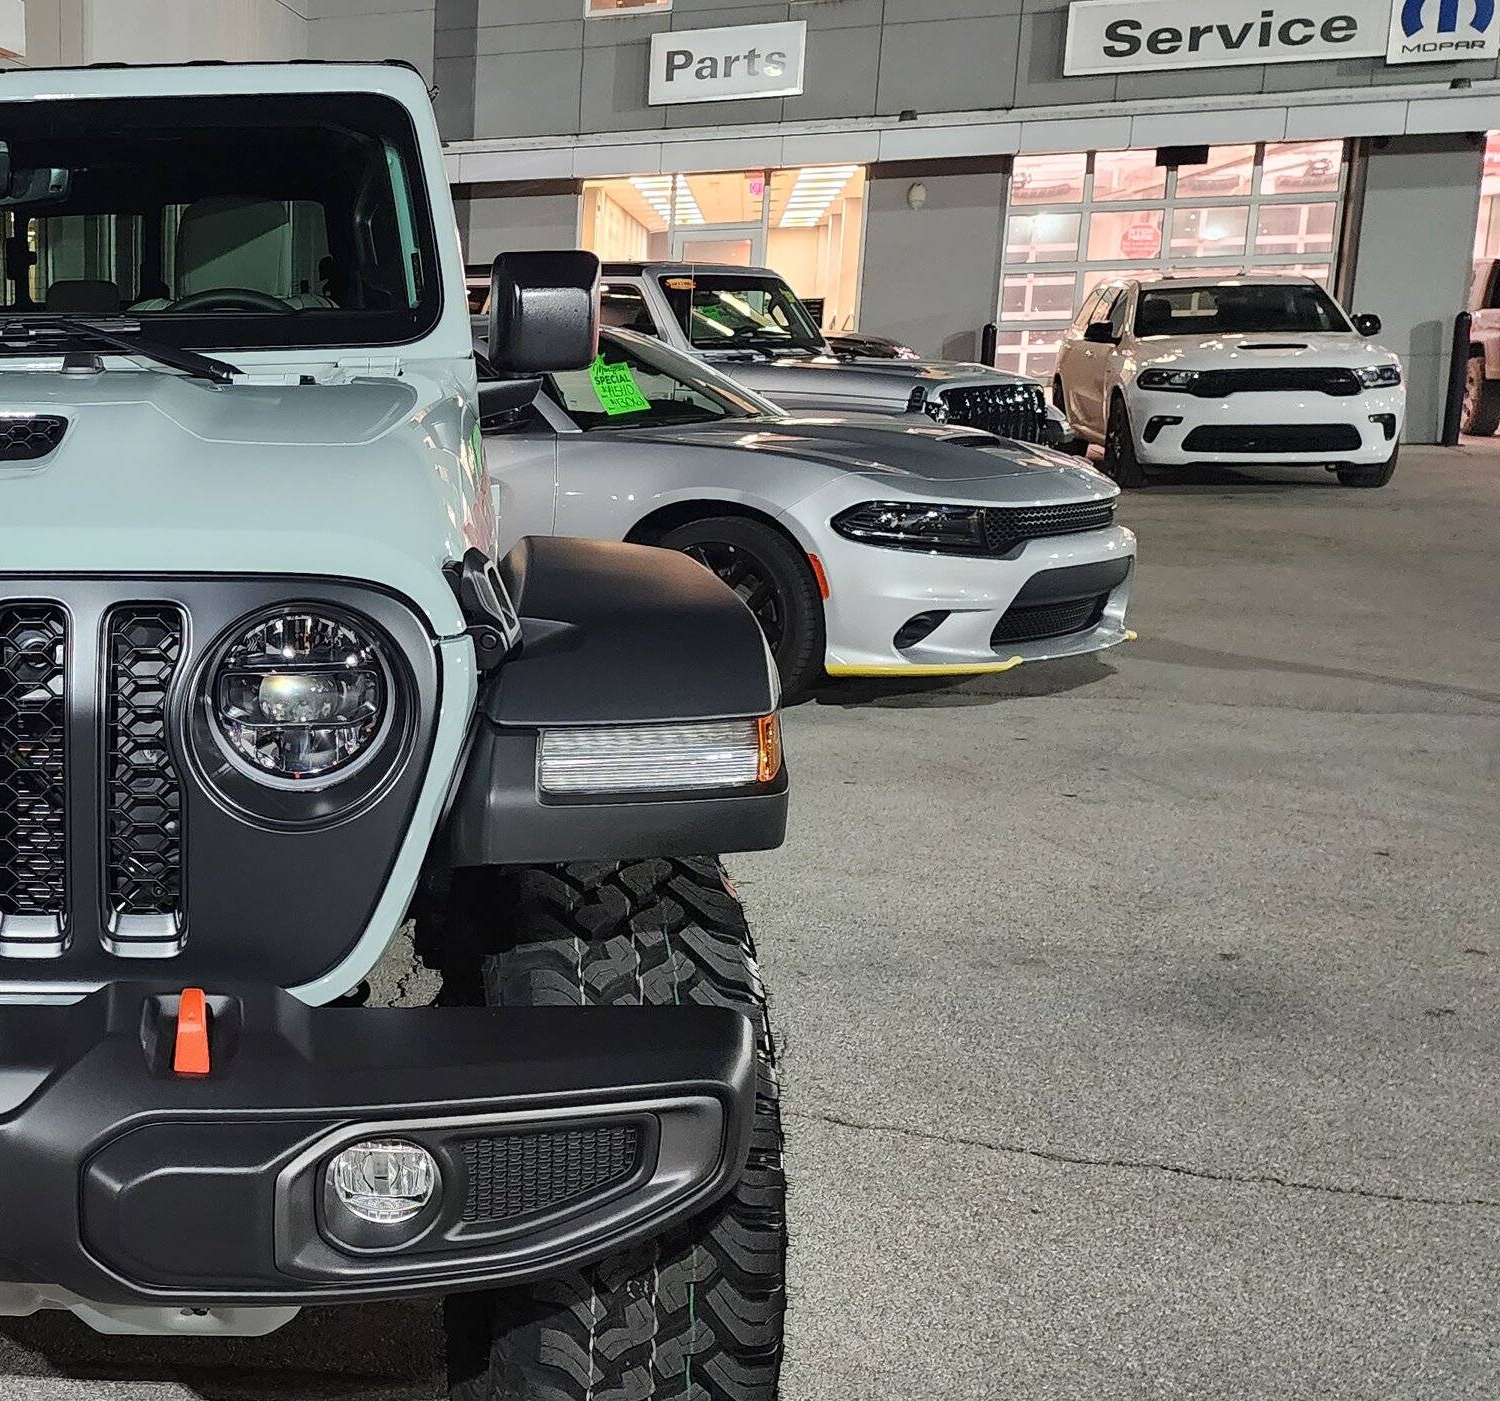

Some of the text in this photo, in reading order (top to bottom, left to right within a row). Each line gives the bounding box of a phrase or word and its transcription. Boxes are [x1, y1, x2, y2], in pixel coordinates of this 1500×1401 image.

[1103, 10, 1359, 58] Service
[1401, 40, 1486, 54] MOPAR
[665, 47, 787, 83] Parts
[594, 374, 632, 385] SPECIAL
